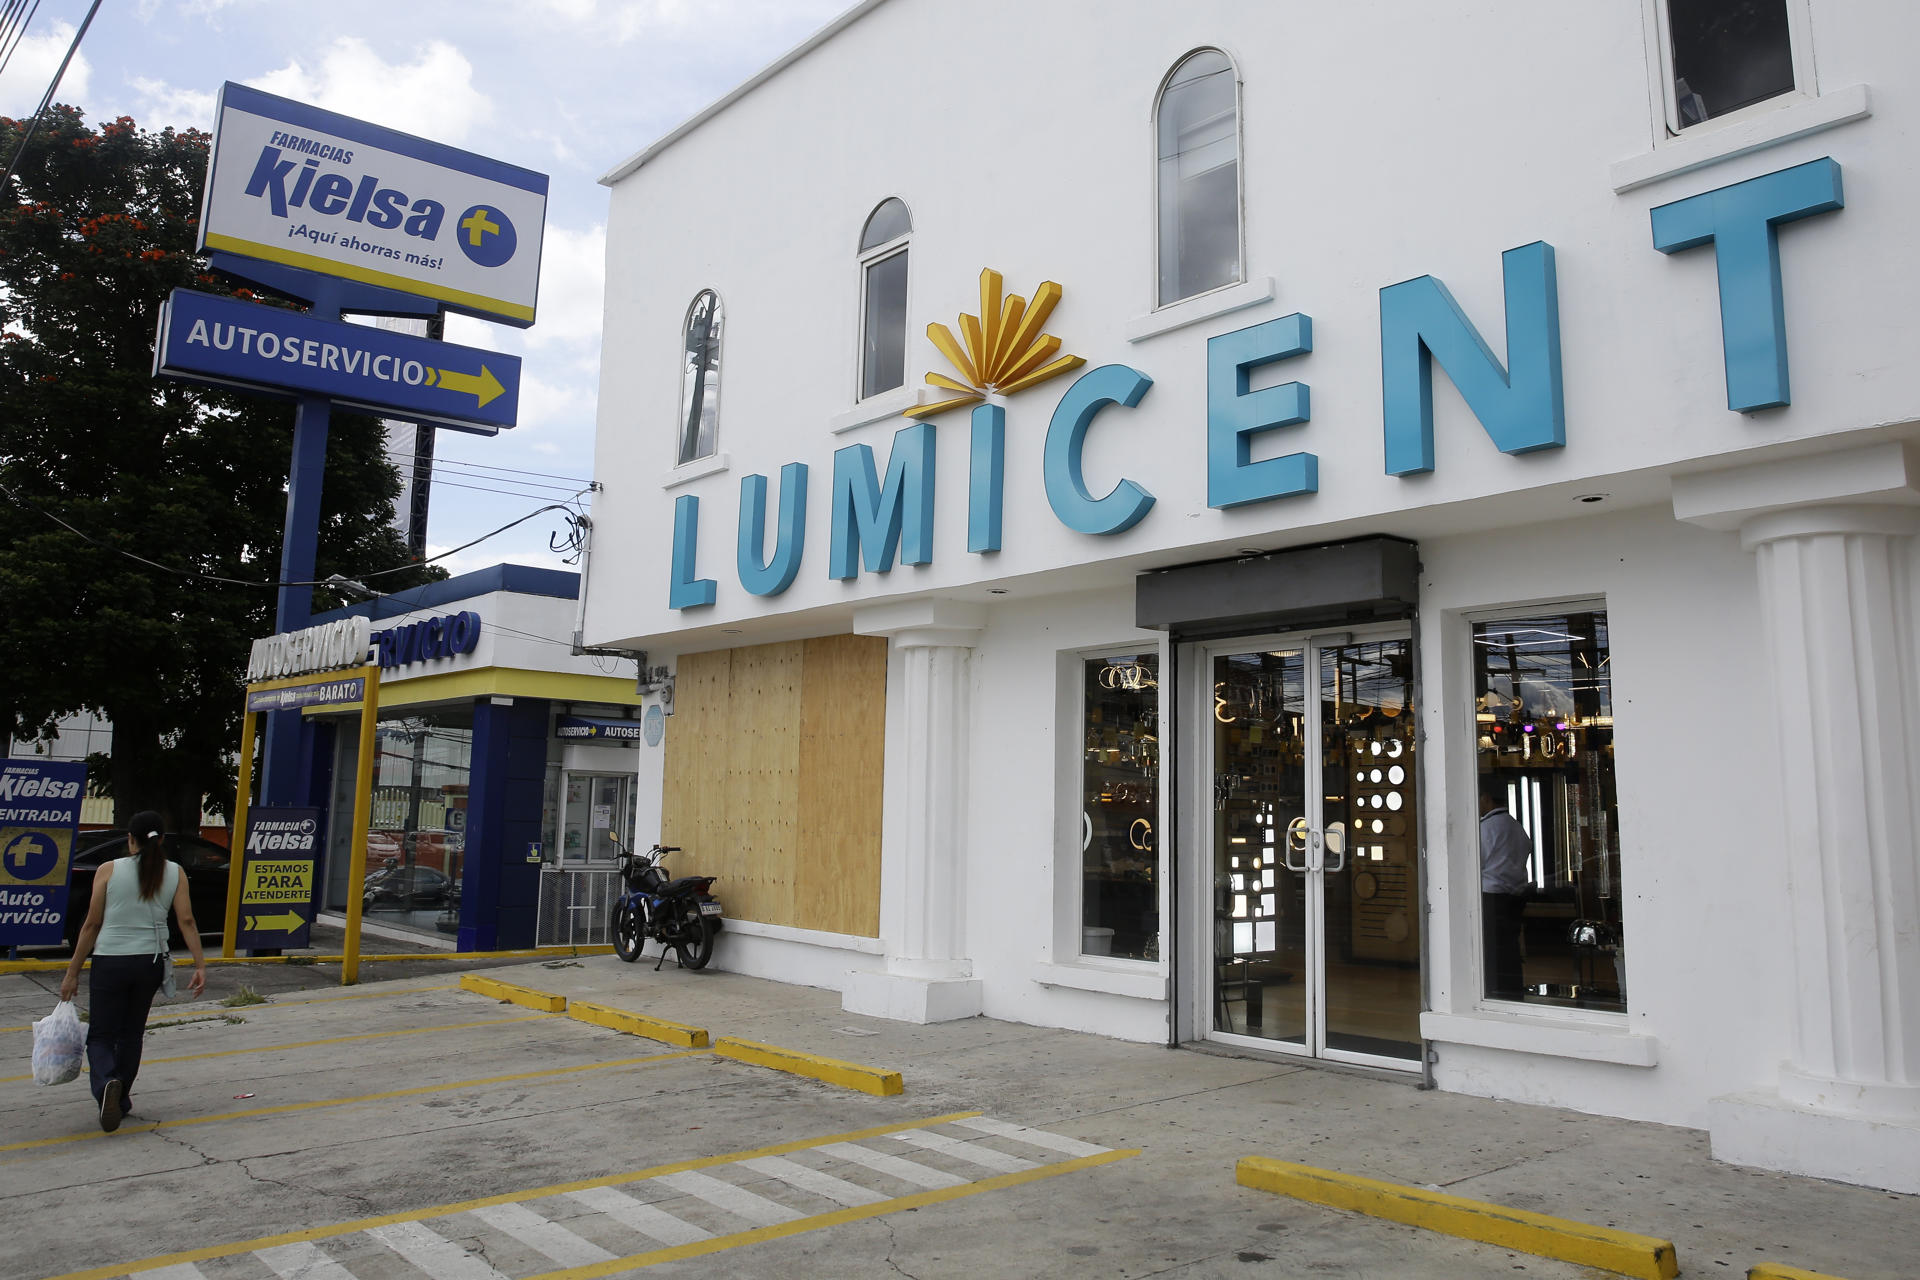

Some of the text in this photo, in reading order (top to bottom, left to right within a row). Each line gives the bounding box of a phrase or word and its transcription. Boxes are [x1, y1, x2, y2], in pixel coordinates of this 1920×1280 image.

[270, 131, 354, 165] FARMACIAS
[288, 223, 444, 270] ¡Aquí ahorras más!
[186, 319, 425, 387] AUTOSERVICIO
[669, 155, 1845, 611] LUMICENT
[247, 615, 371, 680] AUTOSERVICIO
[319, 682, 357, 702] BARATO
[4, 766, 39, 775] FARMACIAS
[0, 808, 72, 823] ENTRADA
[253, 821, 301, 831] FARMACIA
[255, 864, 309, 874] ESTAMOS
[257, 875, 304, 889] PARA
[0, 890, 45, 906] Auto
[244, 889, 312, 900] ATENDERTE
